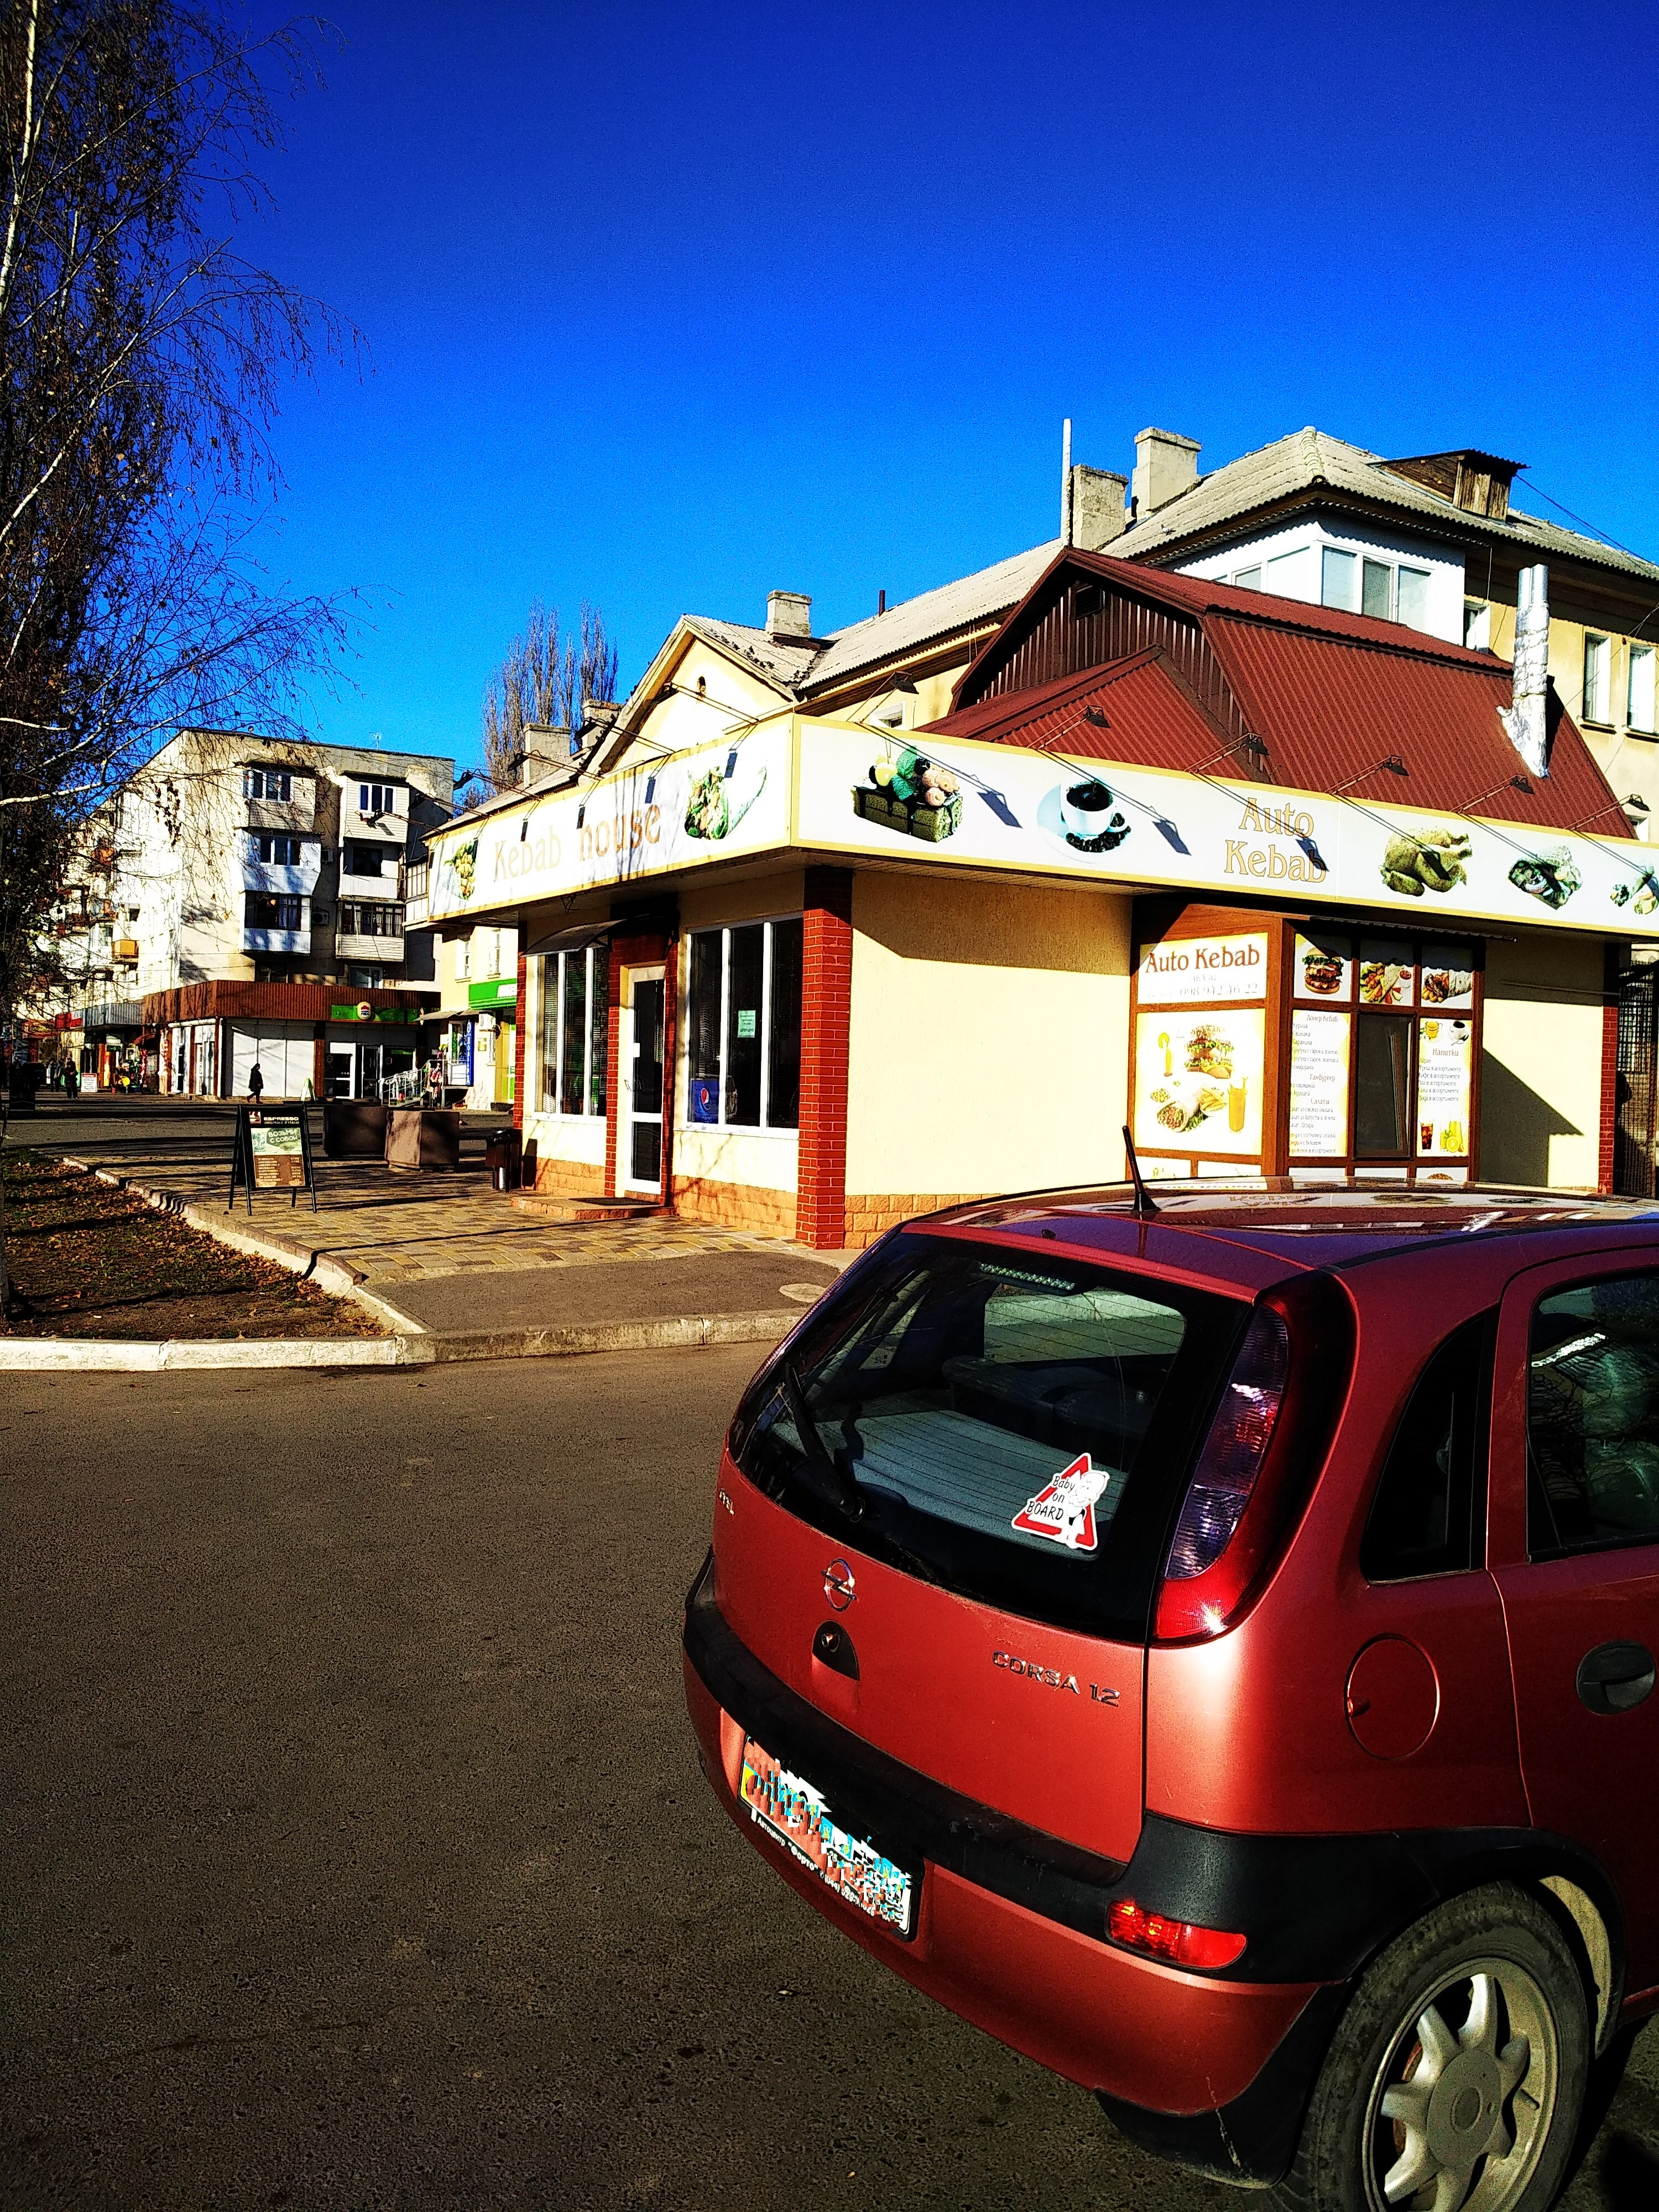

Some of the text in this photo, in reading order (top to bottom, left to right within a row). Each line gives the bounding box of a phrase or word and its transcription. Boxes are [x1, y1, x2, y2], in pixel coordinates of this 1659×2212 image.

[1239, 797, 1314, 838] Auto
[494, 805, 661, 883] Kebab house
[1224, 839, 1326, 883] Kebab
[1145, 943, 1260, 973] Auto Kebab
[1245, 983, 1258, 994] 22
[1432, 1048, 1459, 1056] Напитки
[268, 1129, 297, 1138] ВОЗЬМИ
[1052, 1475, 1076, 1493] Baby
[1026, 1500, 1064, 1521] BOARD
[1052, 1493, 1065, 1503] on
[992, 1650, 1081, 1695] CORSA
[757, 1815, 786, 1846] Автоцентр
[825, 1873, 841, 1893] (044)
